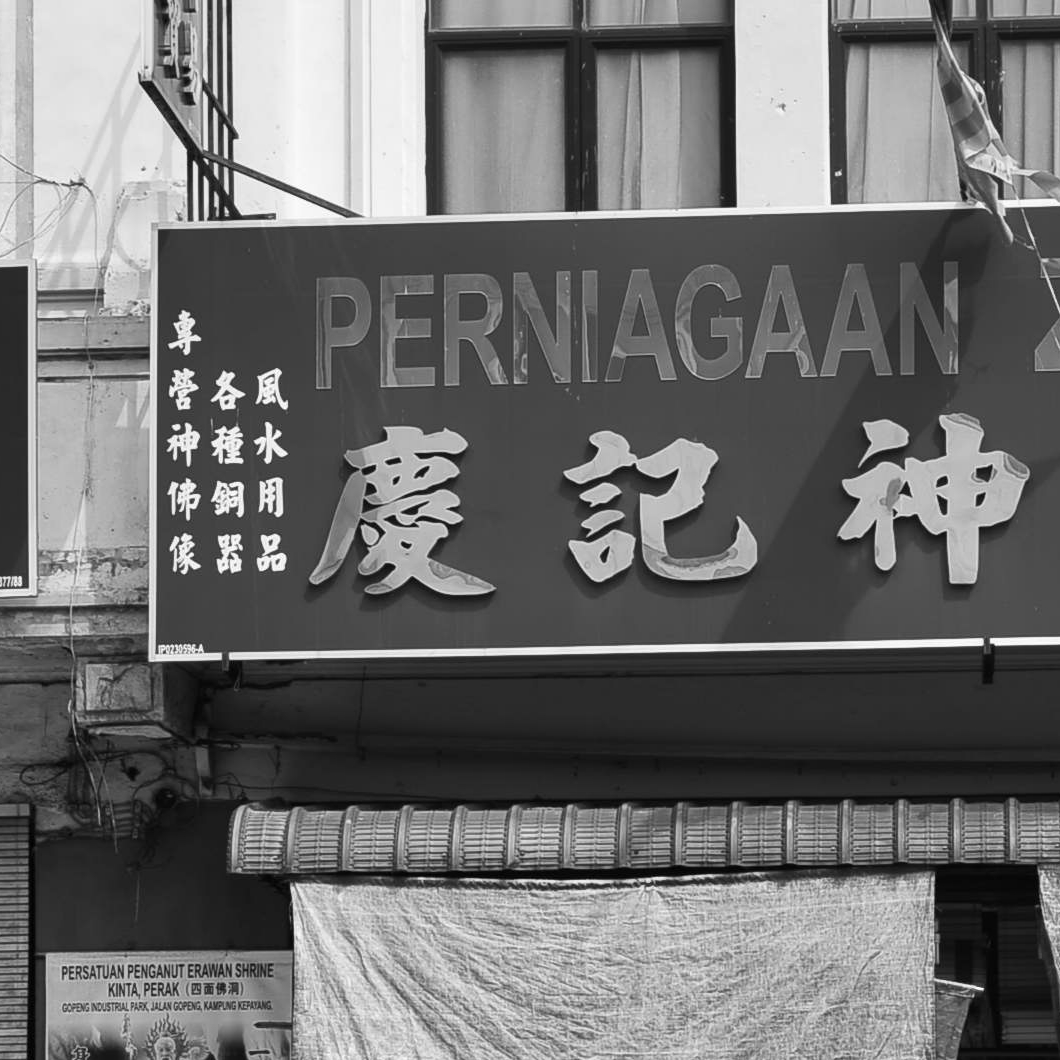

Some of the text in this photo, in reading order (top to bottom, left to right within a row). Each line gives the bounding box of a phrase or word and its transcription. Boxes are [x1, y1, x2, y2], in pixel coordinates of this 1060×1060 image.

[315, 261, 959, 389] PERNIAGAAN
[166, 309, 202, 575] 專營神佛像
[210, 370, 246, 574] 各種銅器
[253, 367, 289, 573] 風水用品
[61, 963, 275, 980] PERSATUAN PENGANUT ERAWAN SHRINE
[62, 1003, 90, 1013] GOPENG
[91, 1002, 129, 1012] INDUSTRIAL
[150, 1001, 172, 1011] JALAN
[203, 1000, 236, 1011] KAMPUNG
[108, 983, 141, 998] KINTA,
[143, 983, 180, 997] PERAK
